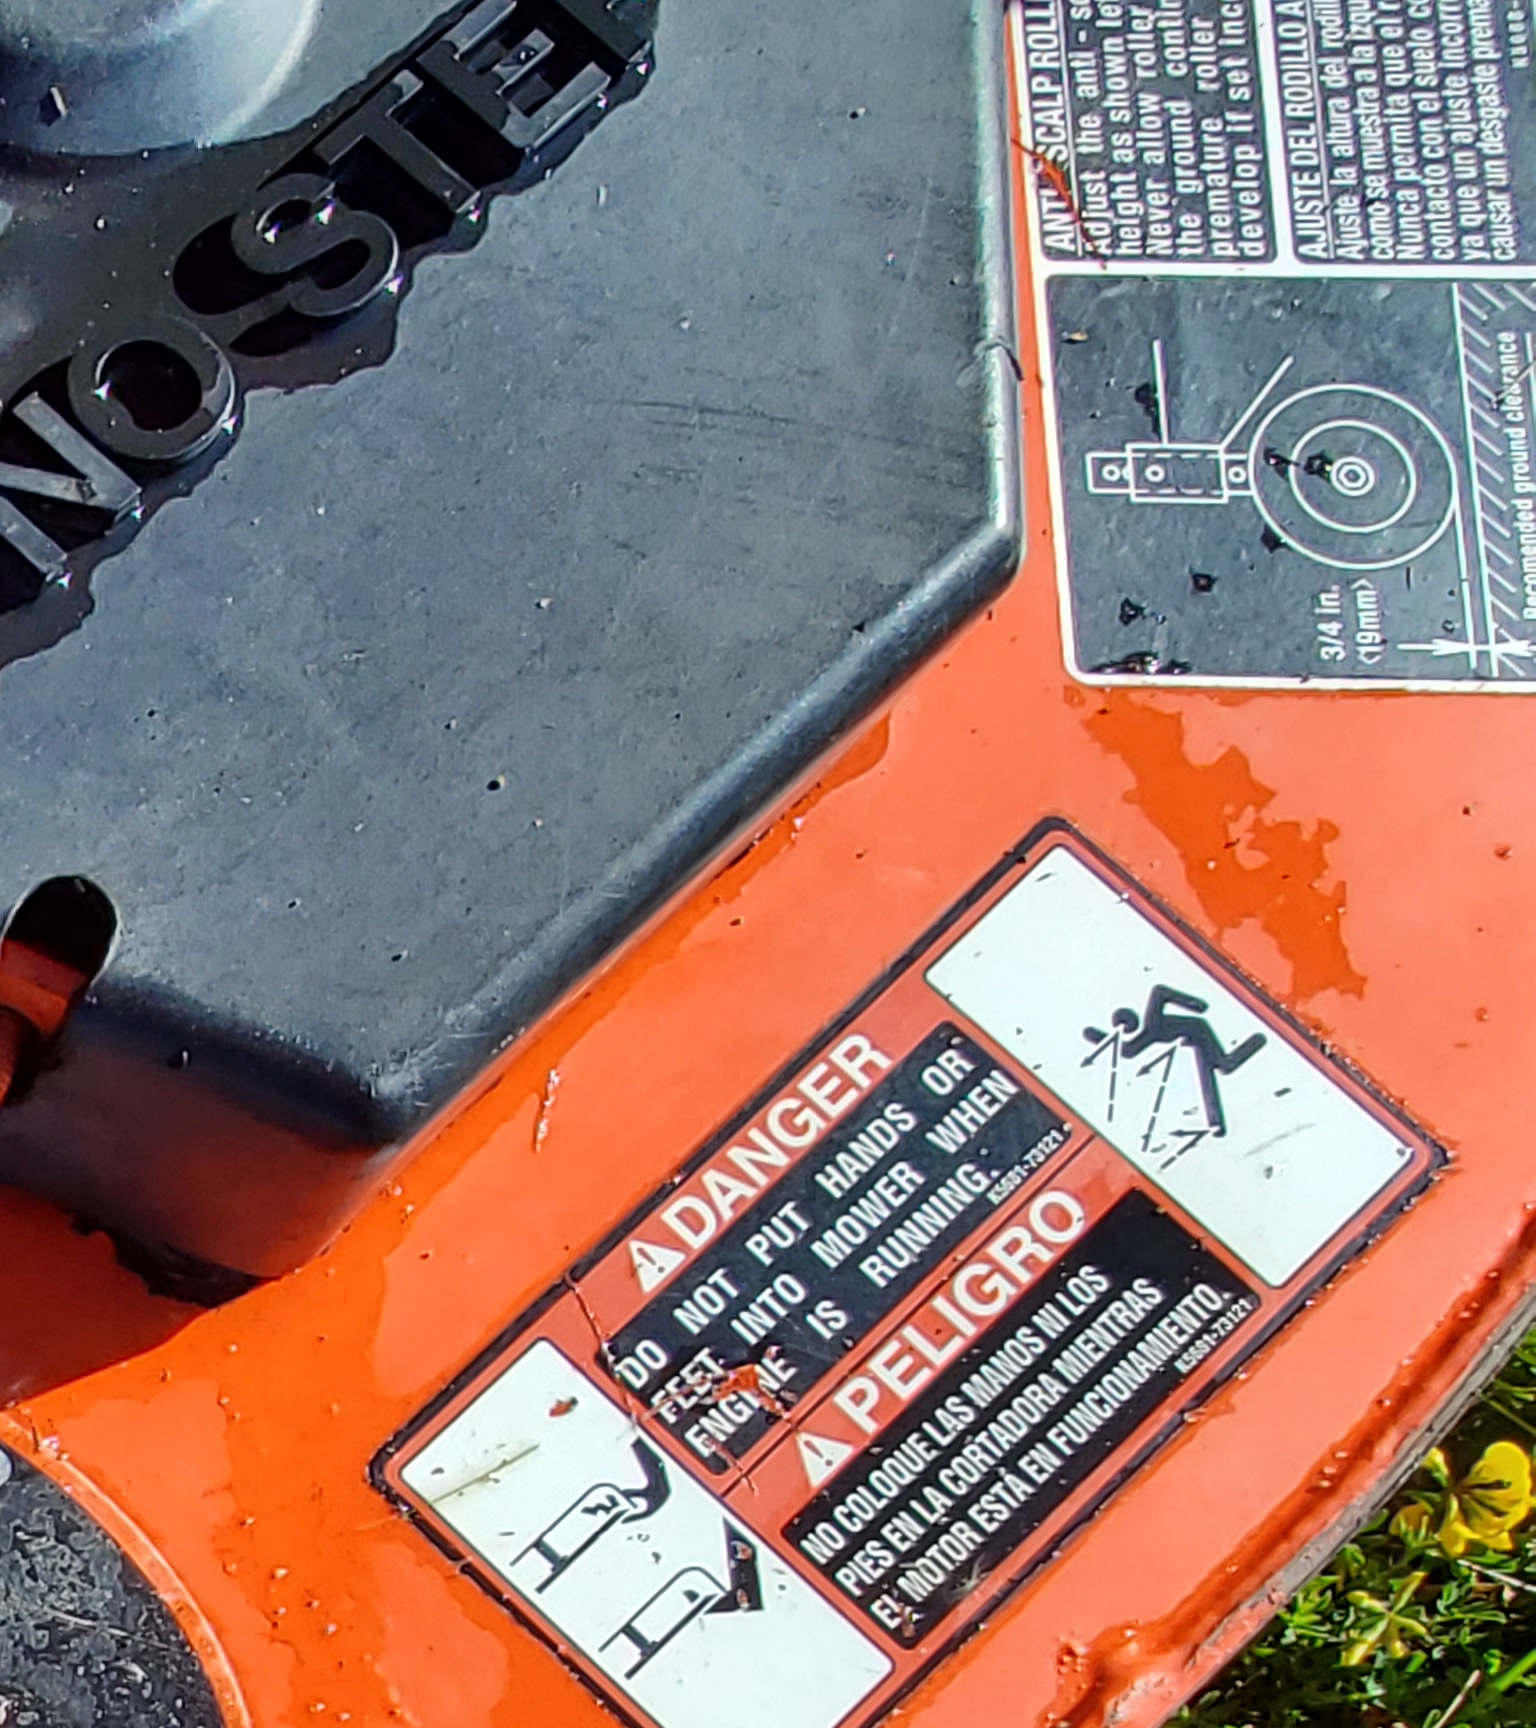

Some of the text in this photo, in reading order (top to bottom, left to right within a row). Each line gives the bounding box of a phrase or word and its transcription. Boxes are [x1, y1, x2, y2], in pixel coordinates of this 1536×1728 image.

[1025, 0, 1063, 69] ROLL
[1347, 45, 1376, 65] la
[1375, 17, 1404, 38] el
[1383, 44, 1413, 86] que
[1405, 27, 1438, 86] suelo
[1069, 52, 1099, 98] anti
[1278, 21, 1314, 116] RODILLO
[1317, 57, 1349, 88] del
[1355, 69, 1377, 82] a
[1411, 92, 1440, 112] el
[1031, 75, 1070, 162] SCALP
[1076, 114, 1103, 153] the
[1095, 0, 1144, 255] height as shown le
[1126, 5, 1174, 255] Never allow roller
[1166, 100, 1201, 193] ground
[1190, 17, 1235, 256] premature roller
[1219, 0, 1266, 256] develop if set inc
[1287, 123, 1319, 165] DEL
[1325, 97, 1355, 156] altura
[1353, 87, 1386, 170] muestra
[1383, 93, 1421, 180] permita
[1420, 118, 1446, 158] con
[1431, 0, 1491, 260] ya que un ajuste incorr
[1472, 64, 1509, 154] desgaste
[1329, 167, 1358, 185] la
[1365, 175, 1389, 198] se
[1421, 164, 1456, 260] contacto
[1484, 160, 1508, 186] un
[1079, 171, 1113, 255] Adjust
[1176, 213, 1204, 256] the
[1292, 171, 1328, 258] AJUSTE
[1333, 195, 1368, 260] Ajuste
[1367, 201, 1395, 259] como
[1396, 191, 1425, 259] Nunca
[1487, 190, 1517, 260] causar
[1498, 332, 1525, 421] clearance
[1507, 428, 1535, 493] ground
[1315, 585, 1346, 660] 3/4 in.
[661, 1035, 893, 1250] DANGER
[614, 1049, 975, 1388] DO NOT PUT HANDS OR
[651, 1070, 1018, 1424] FEET INTO MOWER WHEN
[685, 1164, 1000, 1457] ENGINE IS RUNNING.
[833, 1191, 1085, 1434] PELIGRO
[801, 1266, 1109, 1564] NO COLOQUE LAS MANOS NI LOS
[836, 1278, 1163, 1596] PIES EN LA CORTADORA MIENTRAS
[871, 1284, 1231, 1629] EL MOTOR ESTÁ EN FUNCIONAMIENTO.
